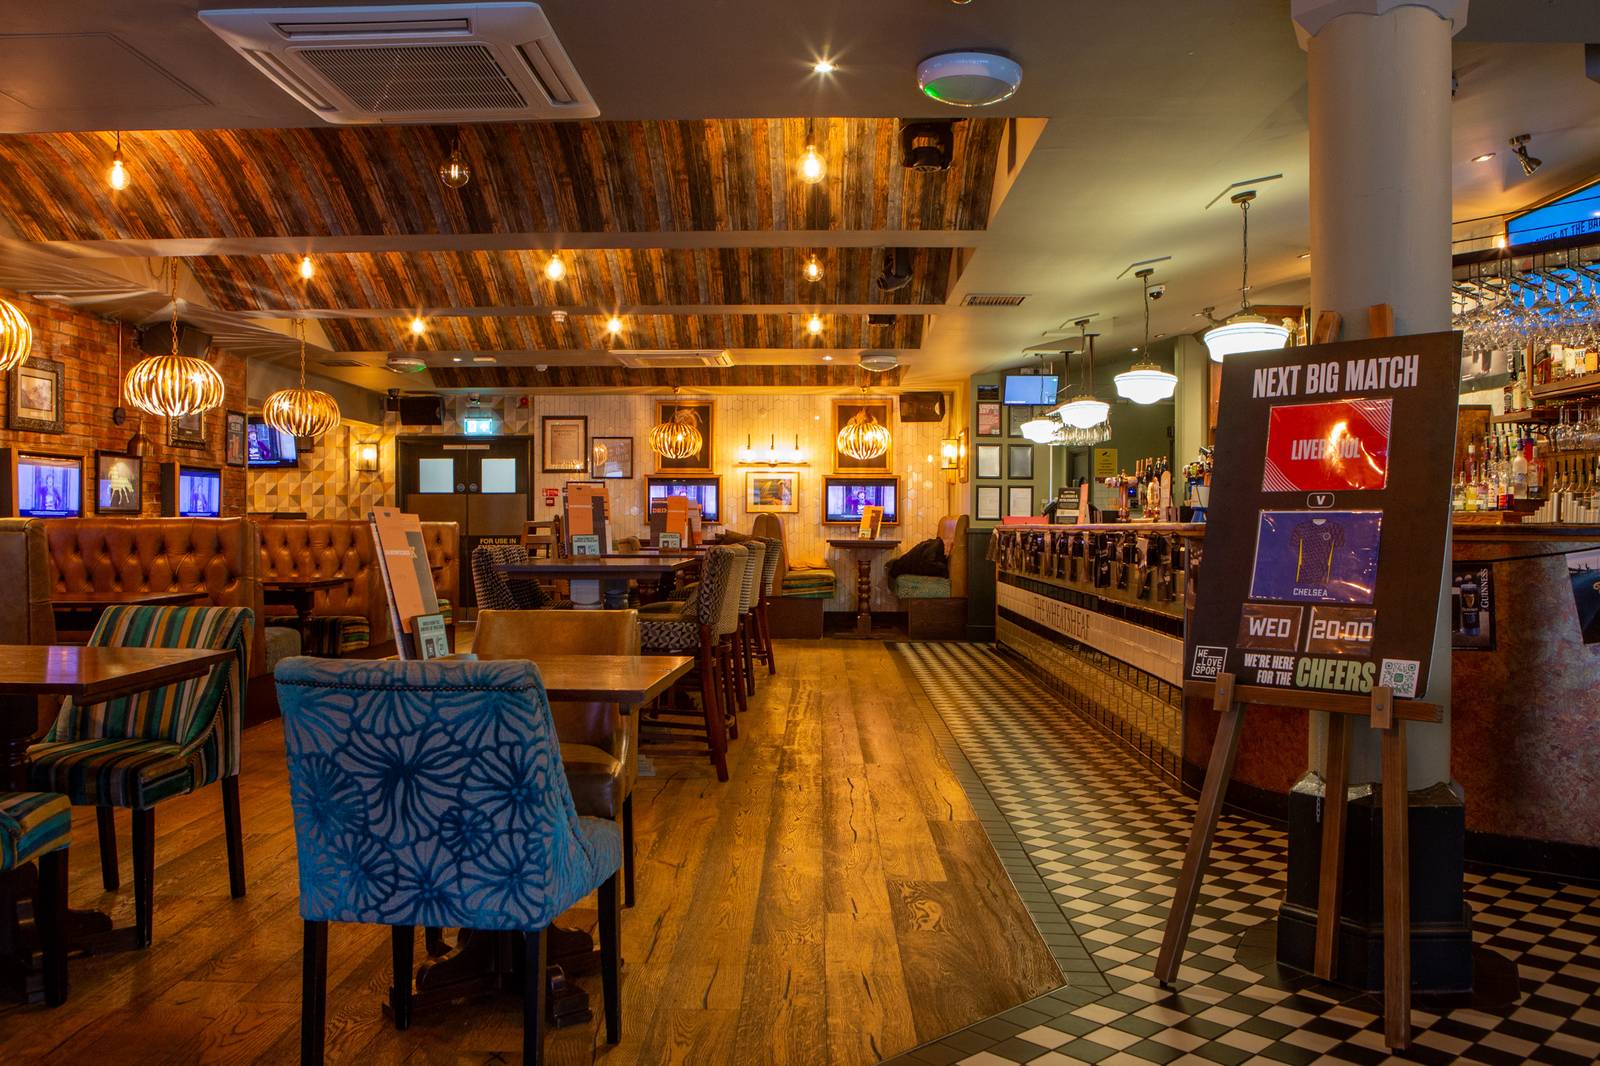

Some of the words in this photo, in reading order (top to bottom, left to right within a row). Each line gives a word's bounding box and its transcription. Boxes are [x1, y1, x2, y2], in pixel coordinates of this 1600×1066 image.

[1559, 227, 1570, 239] AT
[1572, 221, 1585, 236] THE
[1253, 364, 1301, 399] NEXT
[1305, 361, 1340, 395] BIG
[1345, 354, 1419, 391] MATCH
[1291, 437, 1361, 461] LIVEROOL
[480, 537, 493, 545] FOR
[495, 537, 508, 545] USE
[509, 537, 517, 545] IN
[1293, 587, 1328, 597] CHELSEA
[1480, 567, 1489, 609] GUINNESS
[1034, 597, 1046, 622] THE
[1046, 600, 1090, 640] WHEATSHEAF
[1249, 618, 1291, 638] WED
[1312, 620, 1373, 642] 20:00
[1198, 649, 1209, 658] WE
[1244, 653, 1270, 668] WE'RE
[1271, 655, 1295, 670] HERE
[1256, 669, 1274, 683] FOR
[1275, 671, 1292, 686] THE
[1295, 657, 1376, 694] CHEERS
